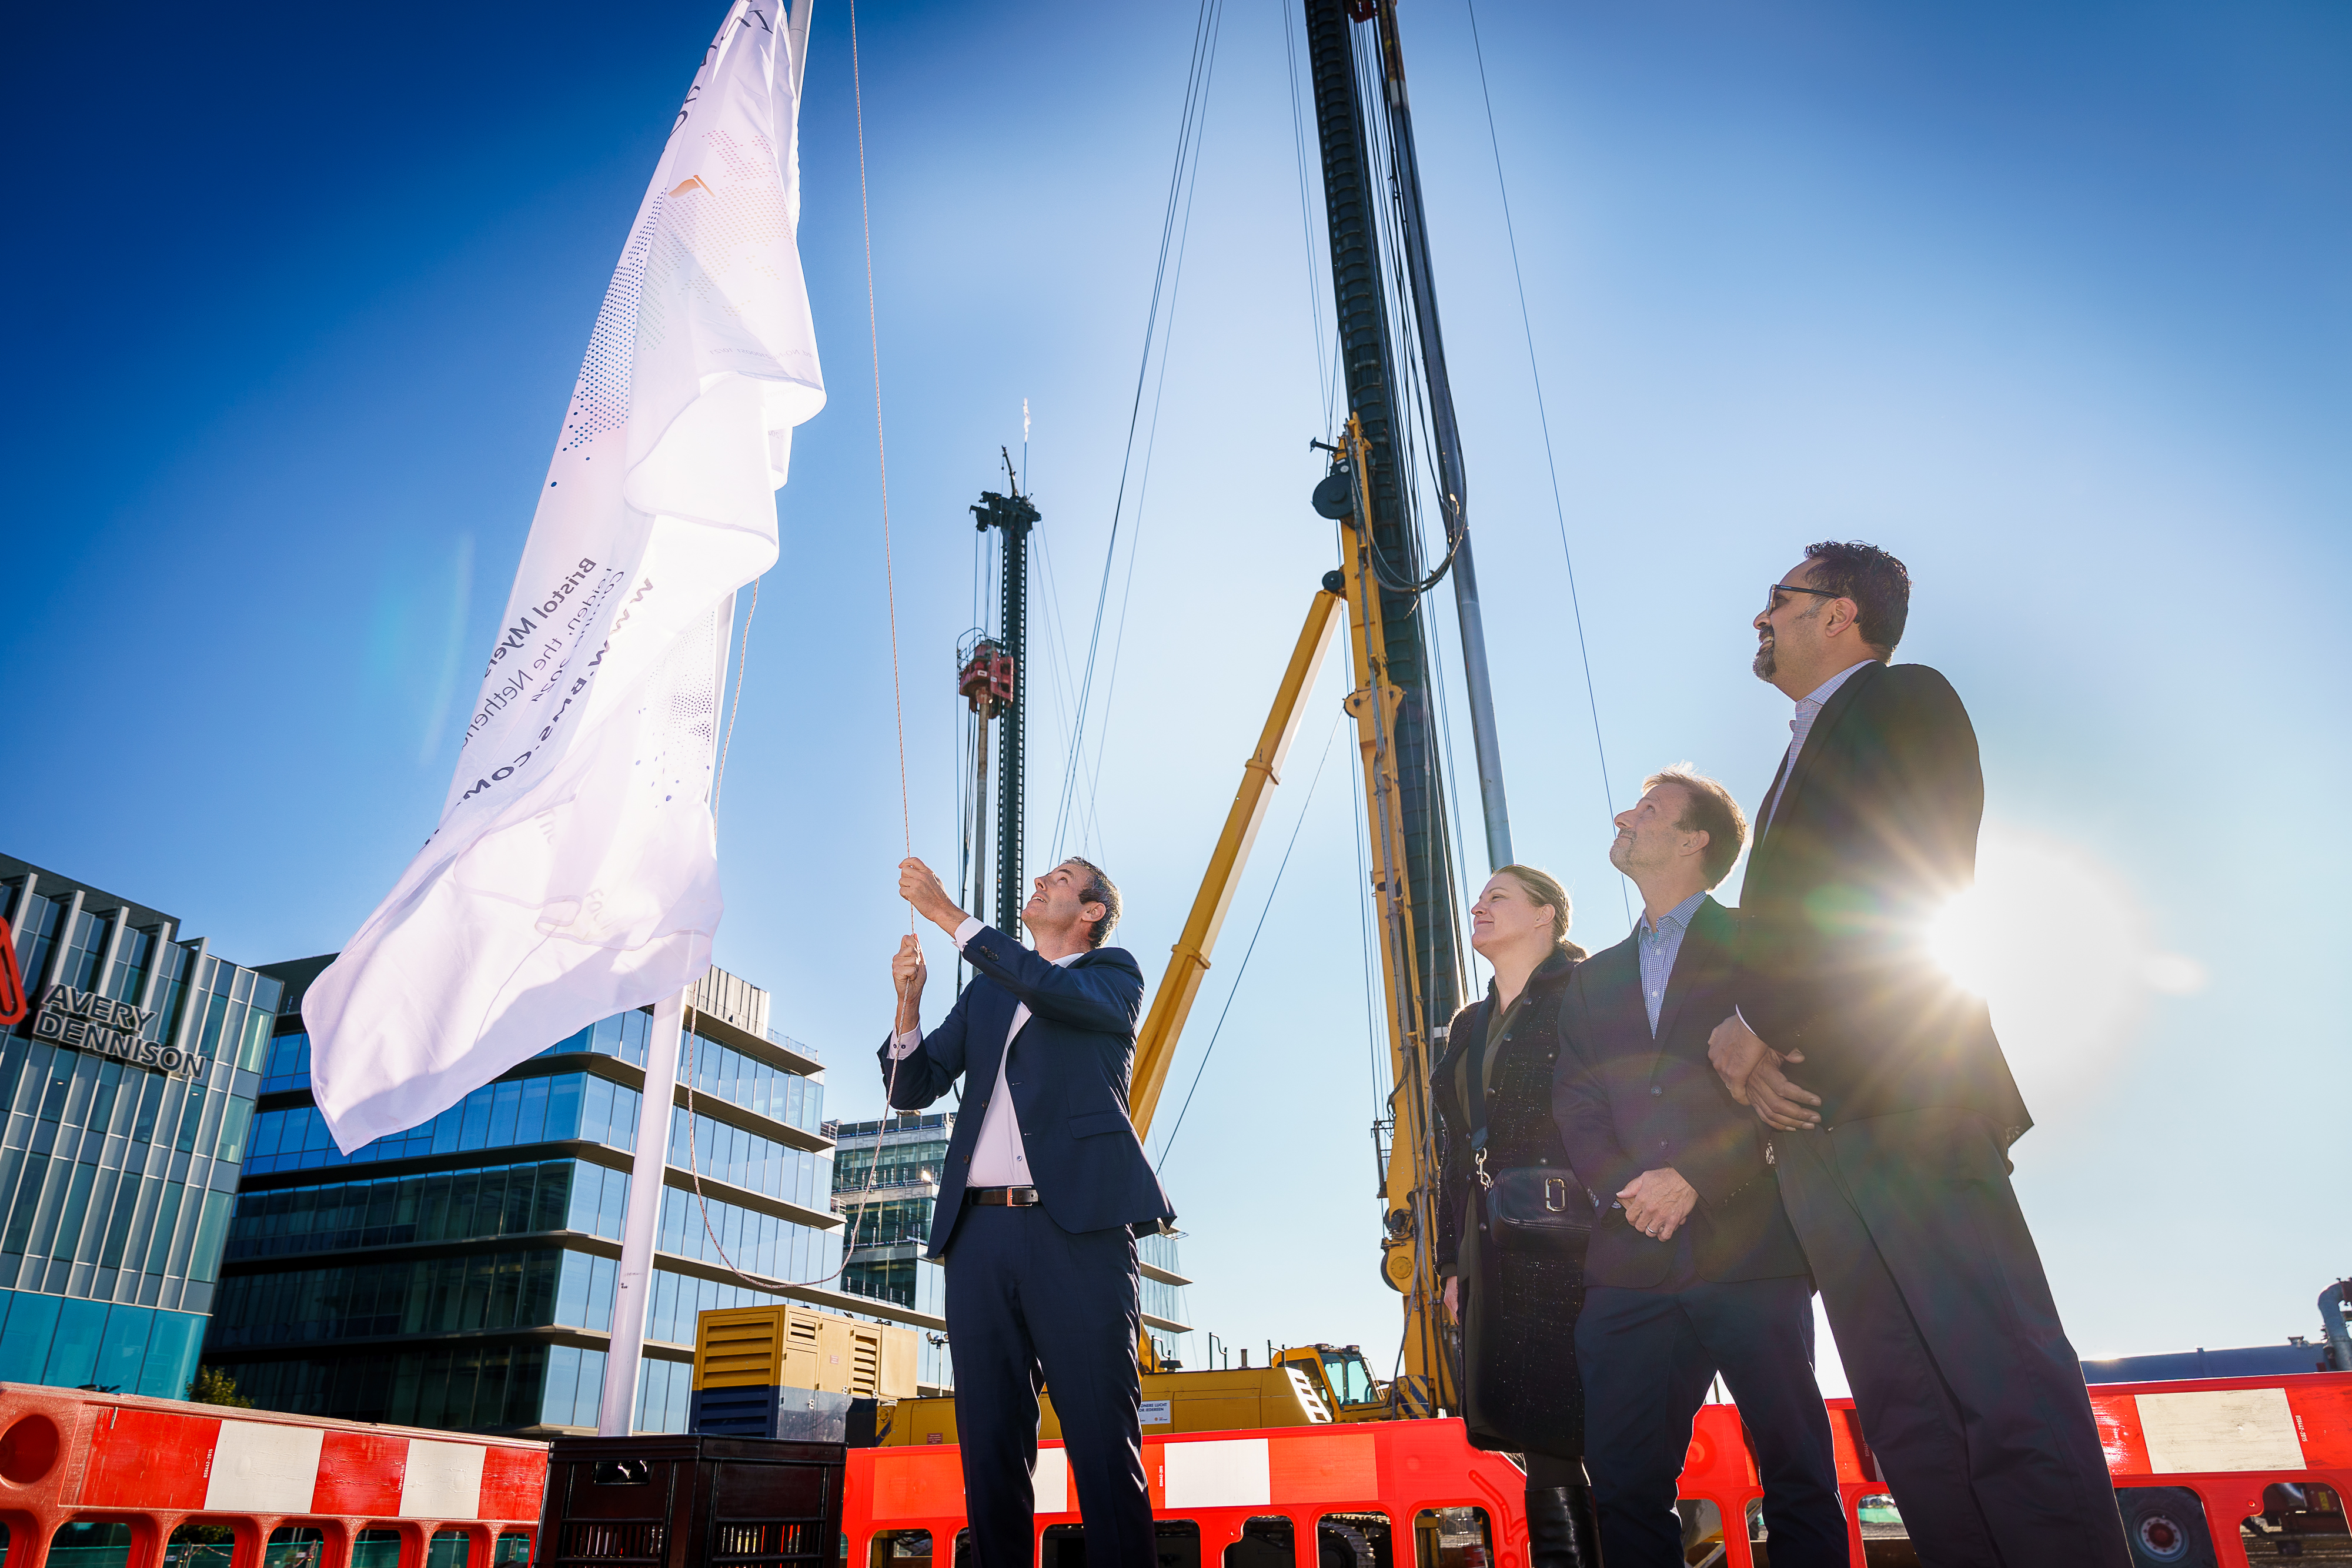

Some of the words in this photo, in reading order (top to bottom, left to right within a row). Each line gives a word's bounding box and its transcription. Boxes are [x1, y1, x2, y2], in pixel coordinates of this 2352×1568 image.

[42, 983, 157, 1032] AVERY
[33, 1009, 206, 1079] DENNISON
[2295, 1415, 2308, 1442] BS8442-2015
[203, 1449, 213, 1478] BS8442-2015
